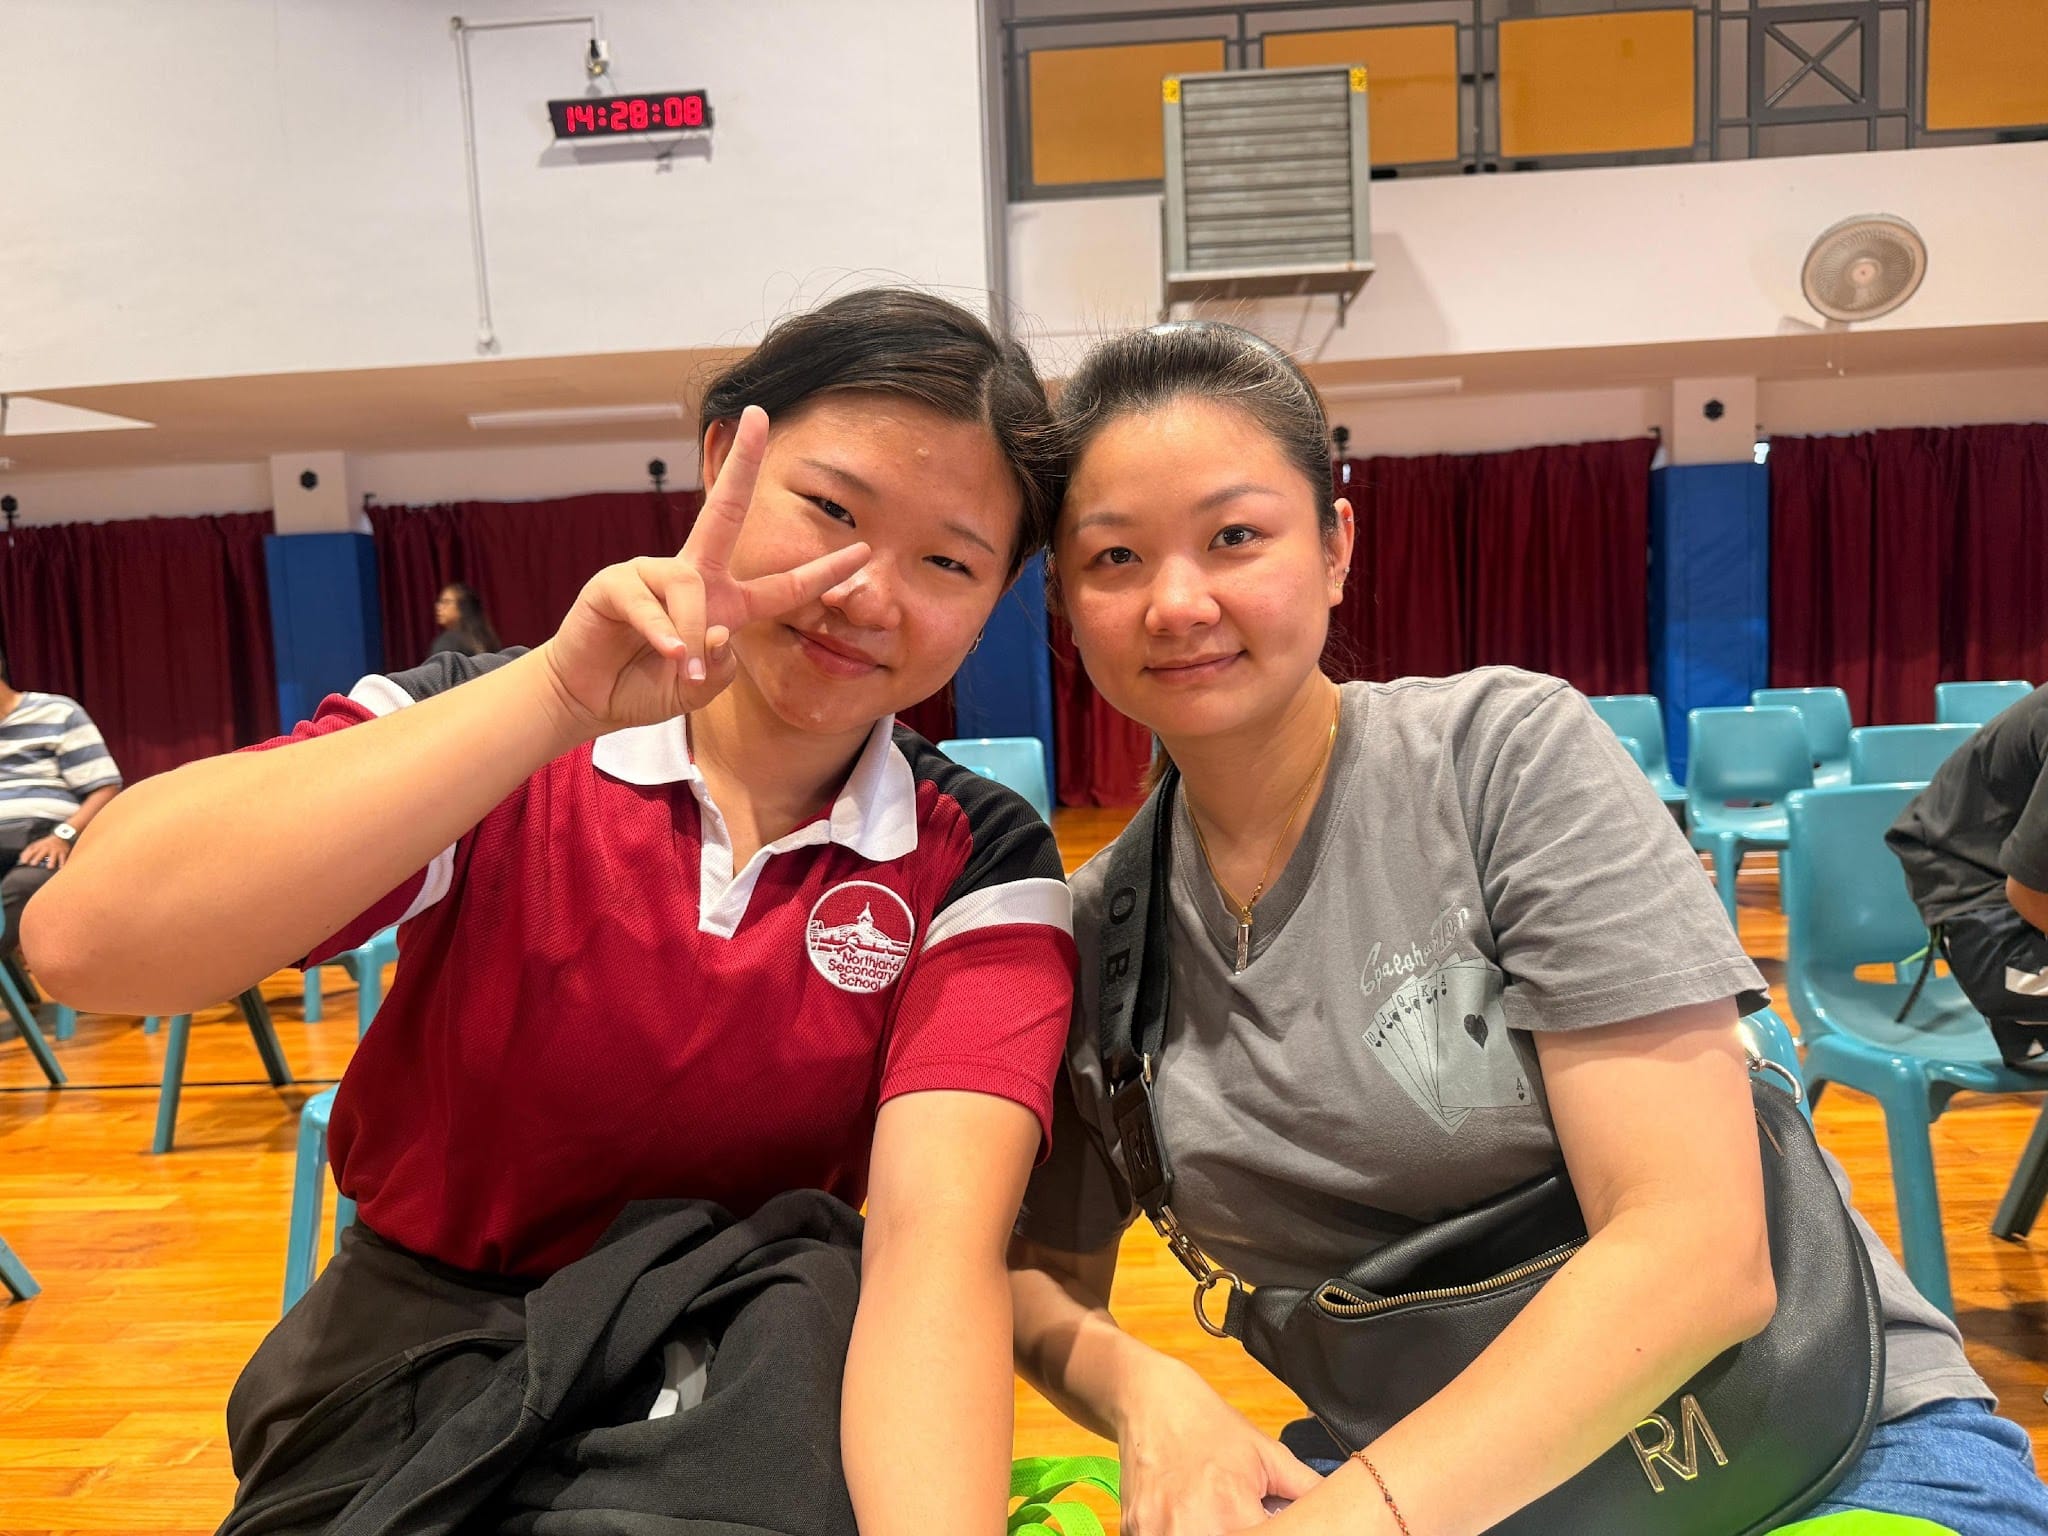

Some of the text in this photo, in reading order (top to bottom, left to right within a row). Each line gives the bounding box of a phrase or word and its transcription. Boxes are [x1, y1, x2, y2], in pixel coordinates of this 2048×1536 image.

[566, 96, 703, 132] 14:28:08
[828, 958, 893, 983] Secondary
[842, 951, 900, 972] Northland
[838, 972, 881, 990] School
[1379, 1012, 1387, 1025] J
[1364, 1031, 1377, 1047] 10
[1515, 1076, 1524, 1090] A
